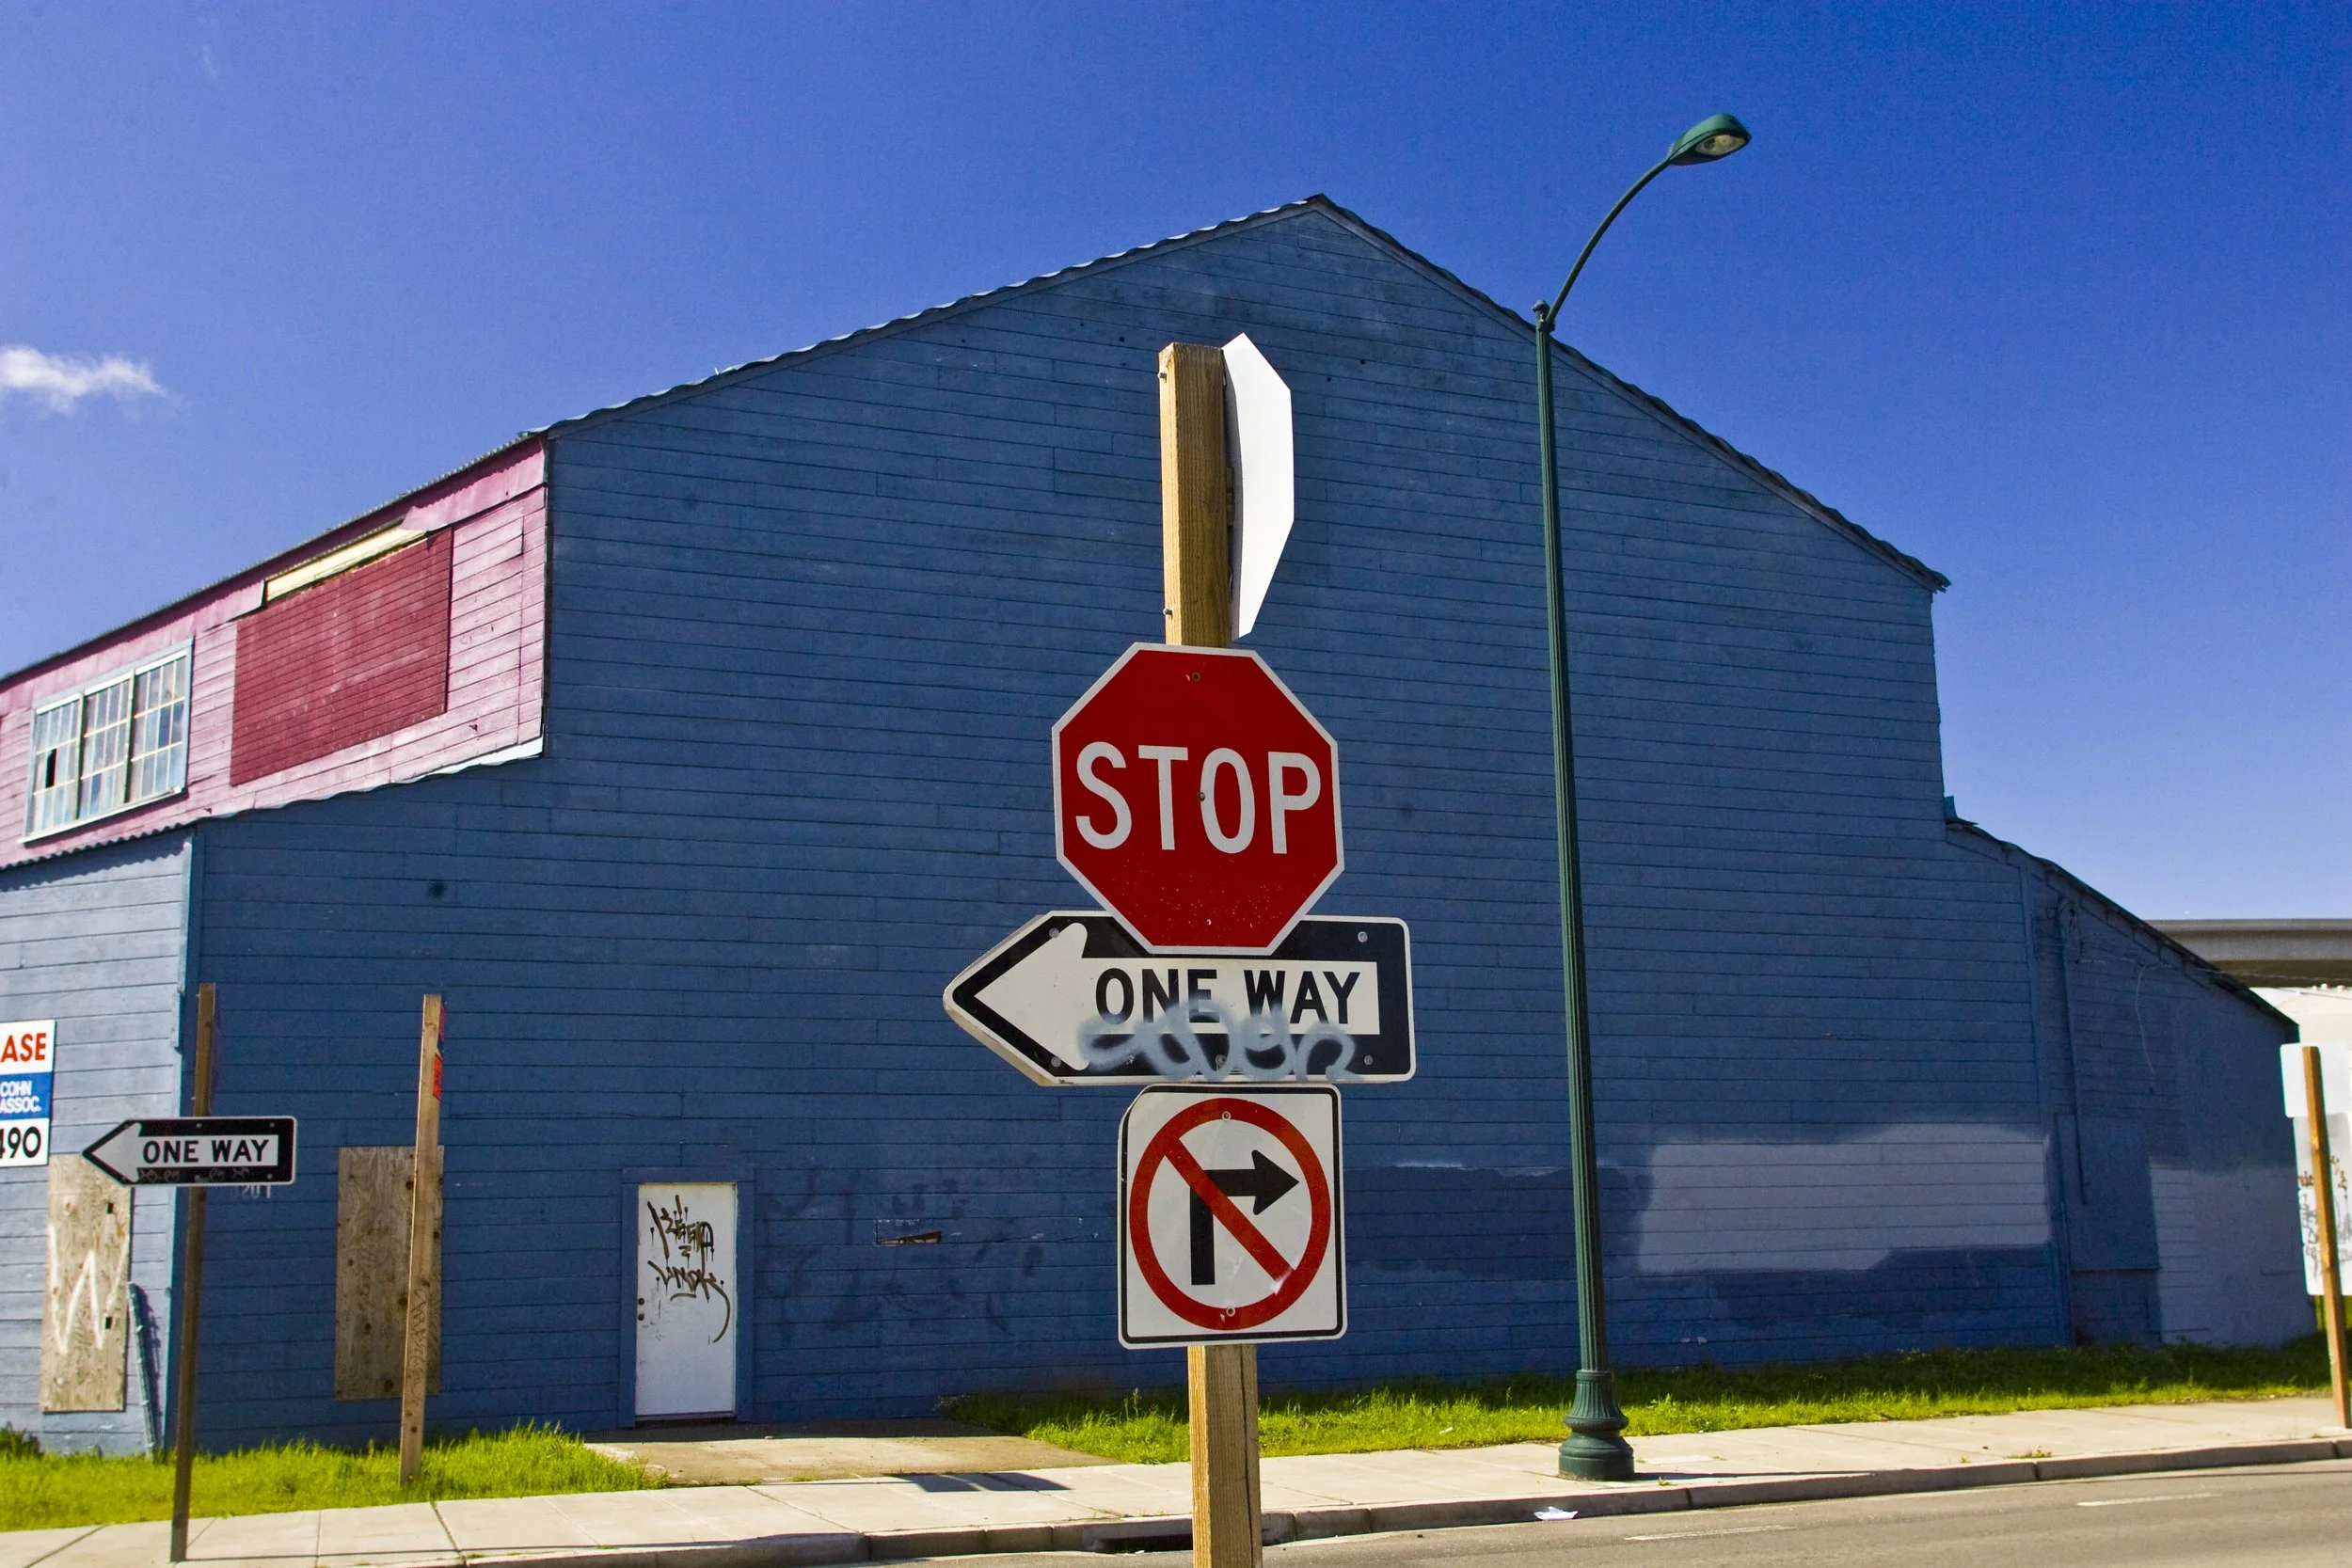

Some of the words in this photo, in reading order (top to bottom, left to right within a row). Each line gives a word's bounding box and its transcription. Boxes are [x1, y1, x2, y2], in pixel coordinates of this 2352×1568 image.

[1075, 741, 1321, 855] STOP
[1095, 967, 1220, 1025] ONE
[1244, 970, 1360, 1025] WAY
[143, 1140, 199, 1164] ONE
[212, 1139, 269, 1163] WAY
